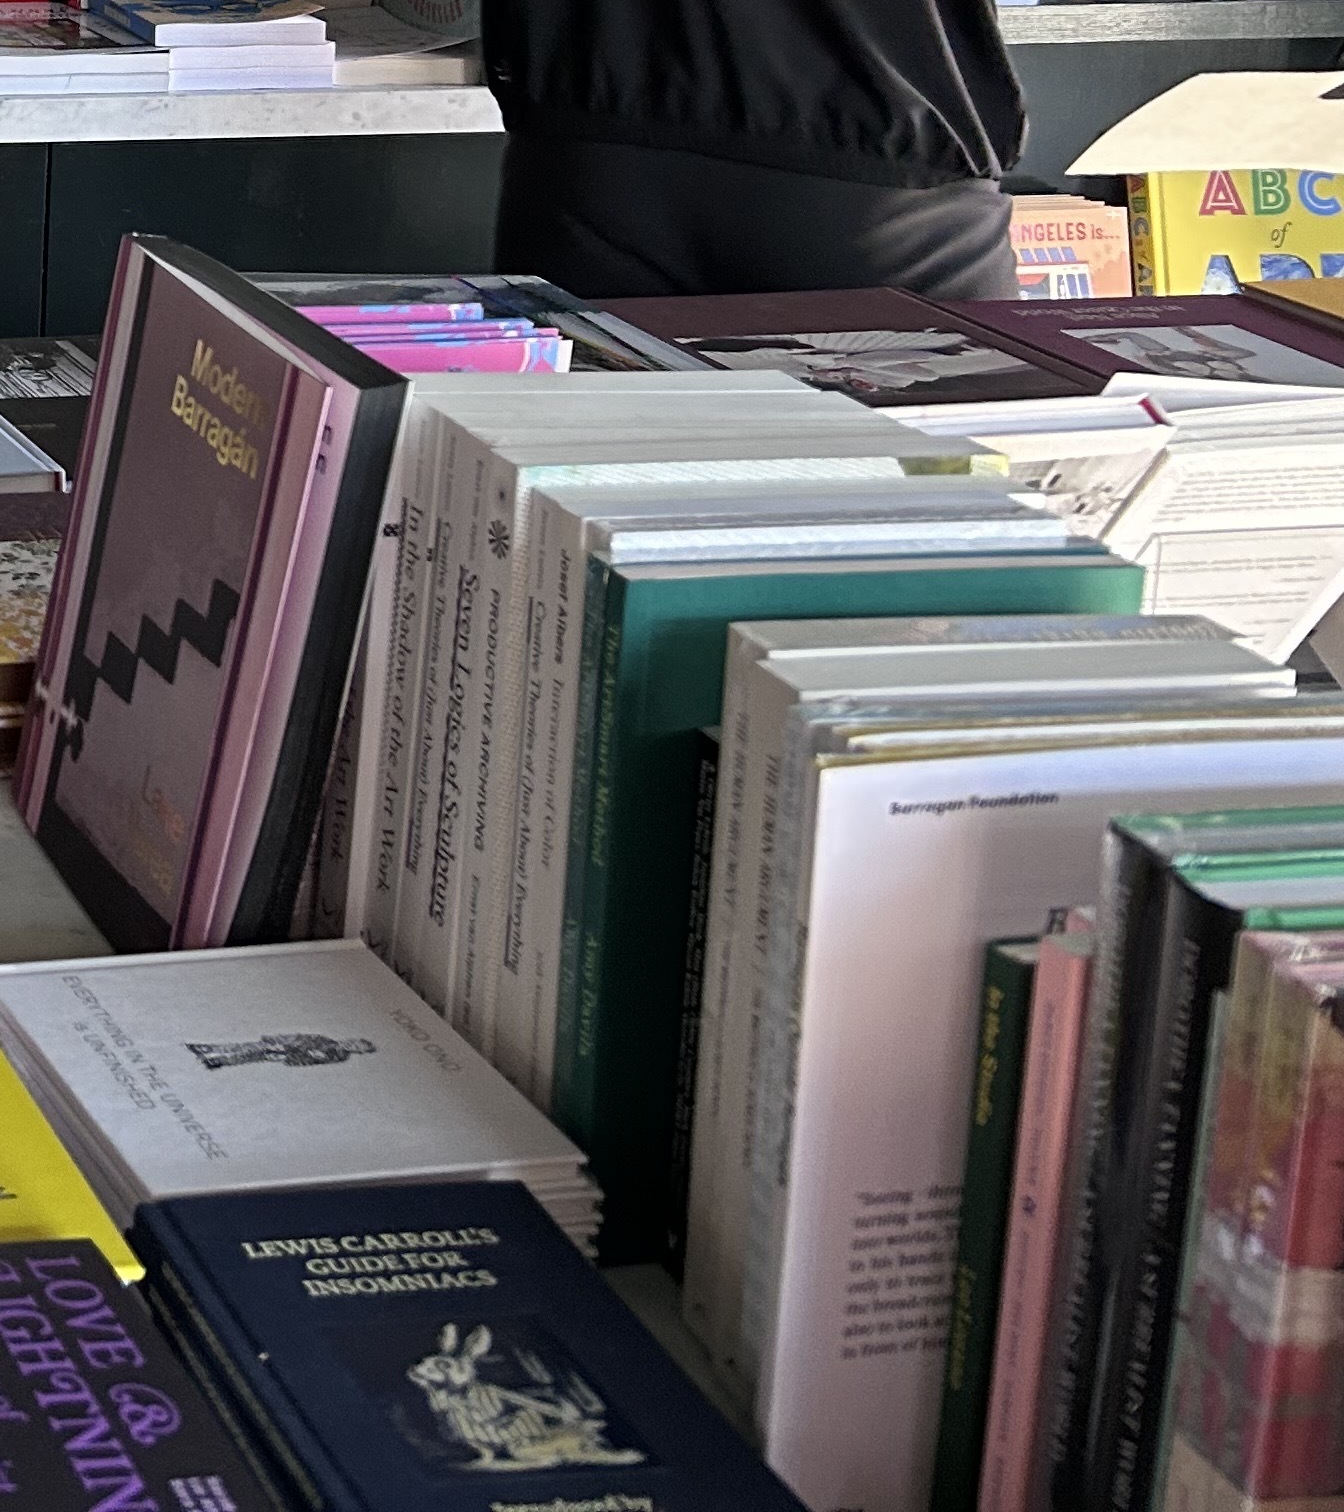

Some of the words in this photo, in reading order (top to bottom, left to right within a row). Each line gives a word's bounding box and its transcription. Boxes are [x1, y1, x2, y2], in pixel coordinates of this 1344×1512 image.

[1270, 221, 1293, 249] of
[242, 1237, 340, 1259] LEWIS
[341, 1227, 501, 1256] CARROLL'S
[306, 1251, 407, 1276] GUIDE
[411, 1249, 466, 1269] FOR
[303, 1269, 498, 1297] INSOMNIACS
